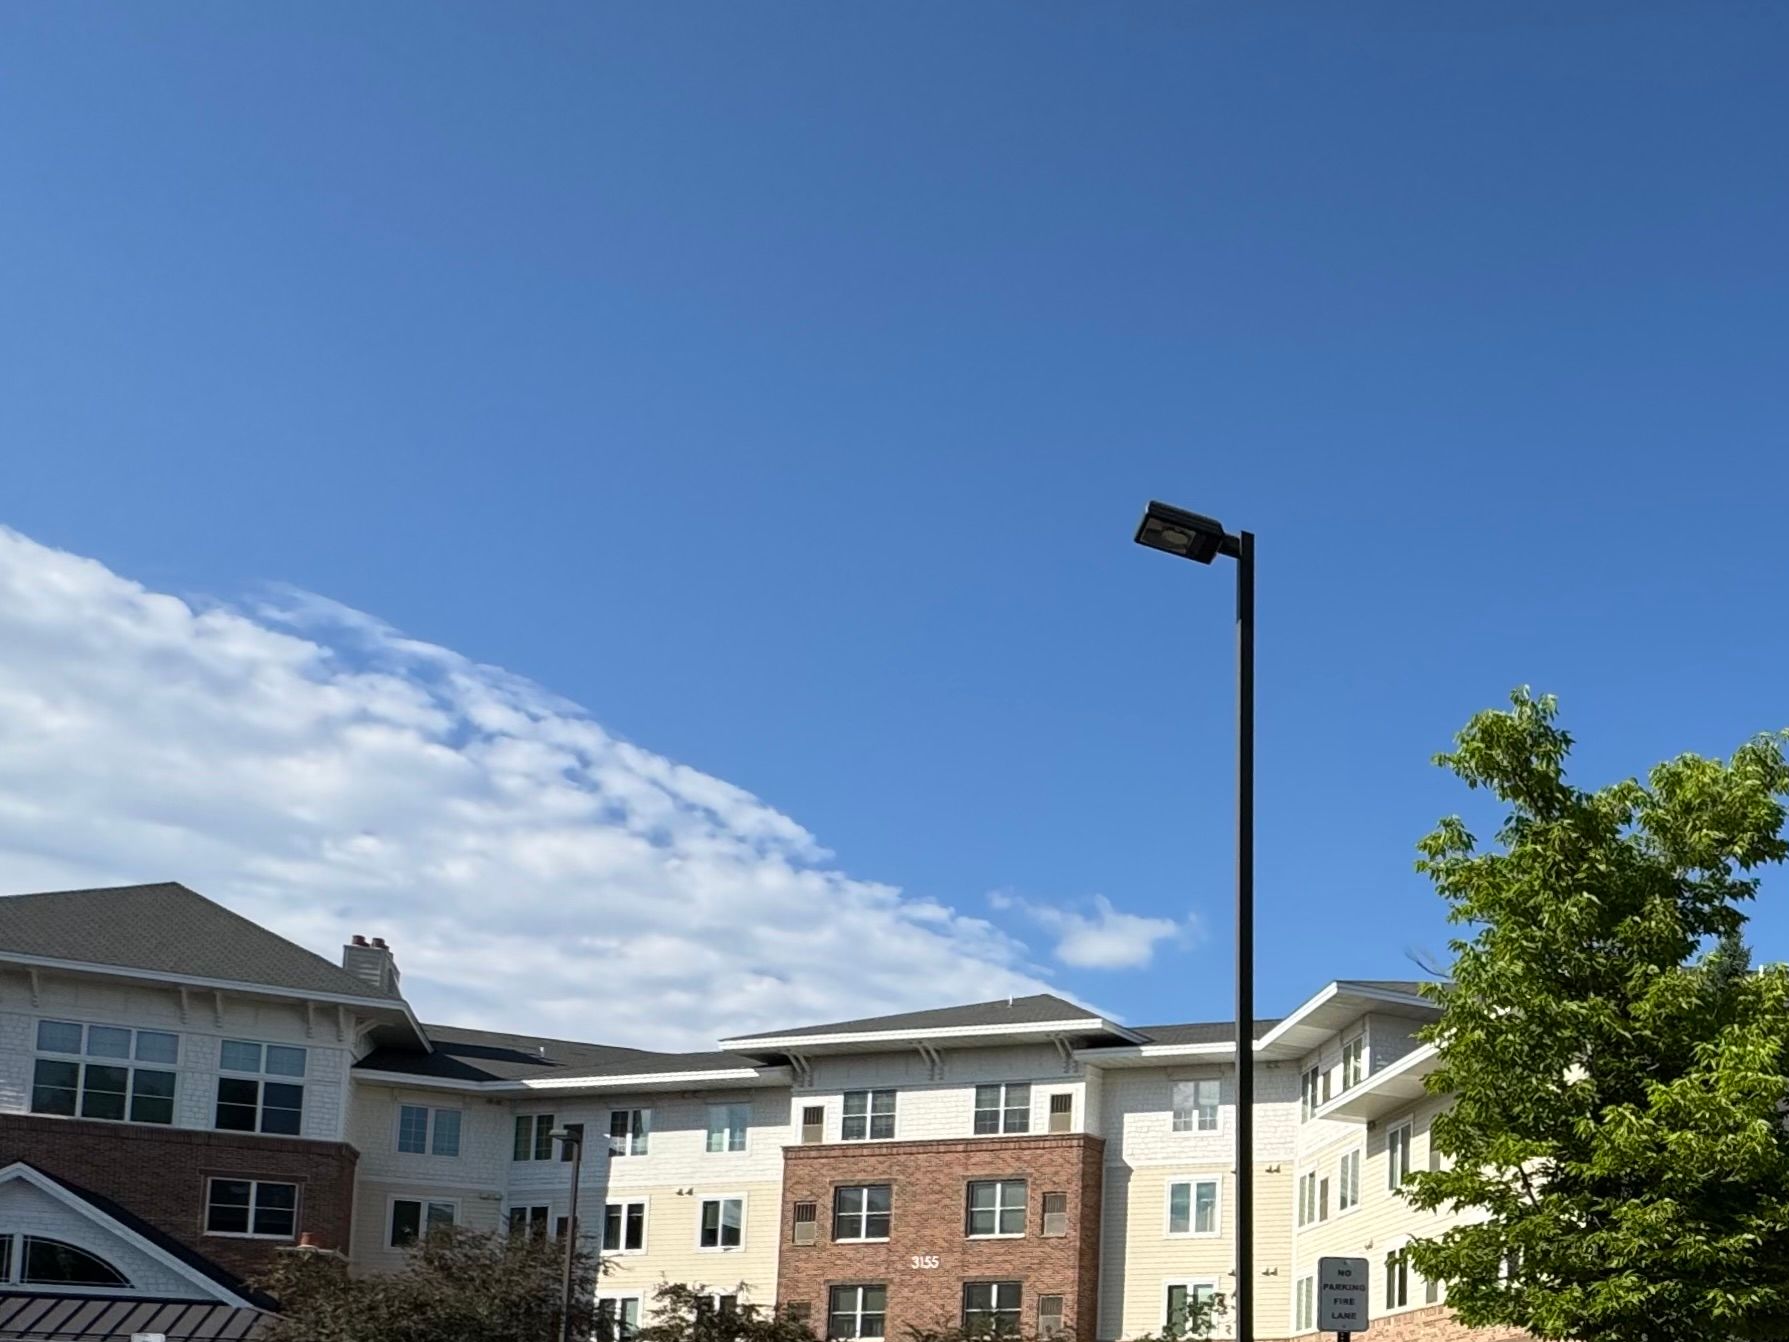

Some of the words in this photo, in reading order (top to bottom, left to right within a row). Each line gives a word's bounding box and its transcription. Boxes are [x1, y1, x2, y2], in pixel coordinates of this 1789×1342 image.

[1337, 1269, 1352, 1277] NO
[1323, 1283, 1366, 1292] PARKING
[1333, 1297, 1355, 1306] FIRE
[1331, 1311, 1357, 1320] LANE
